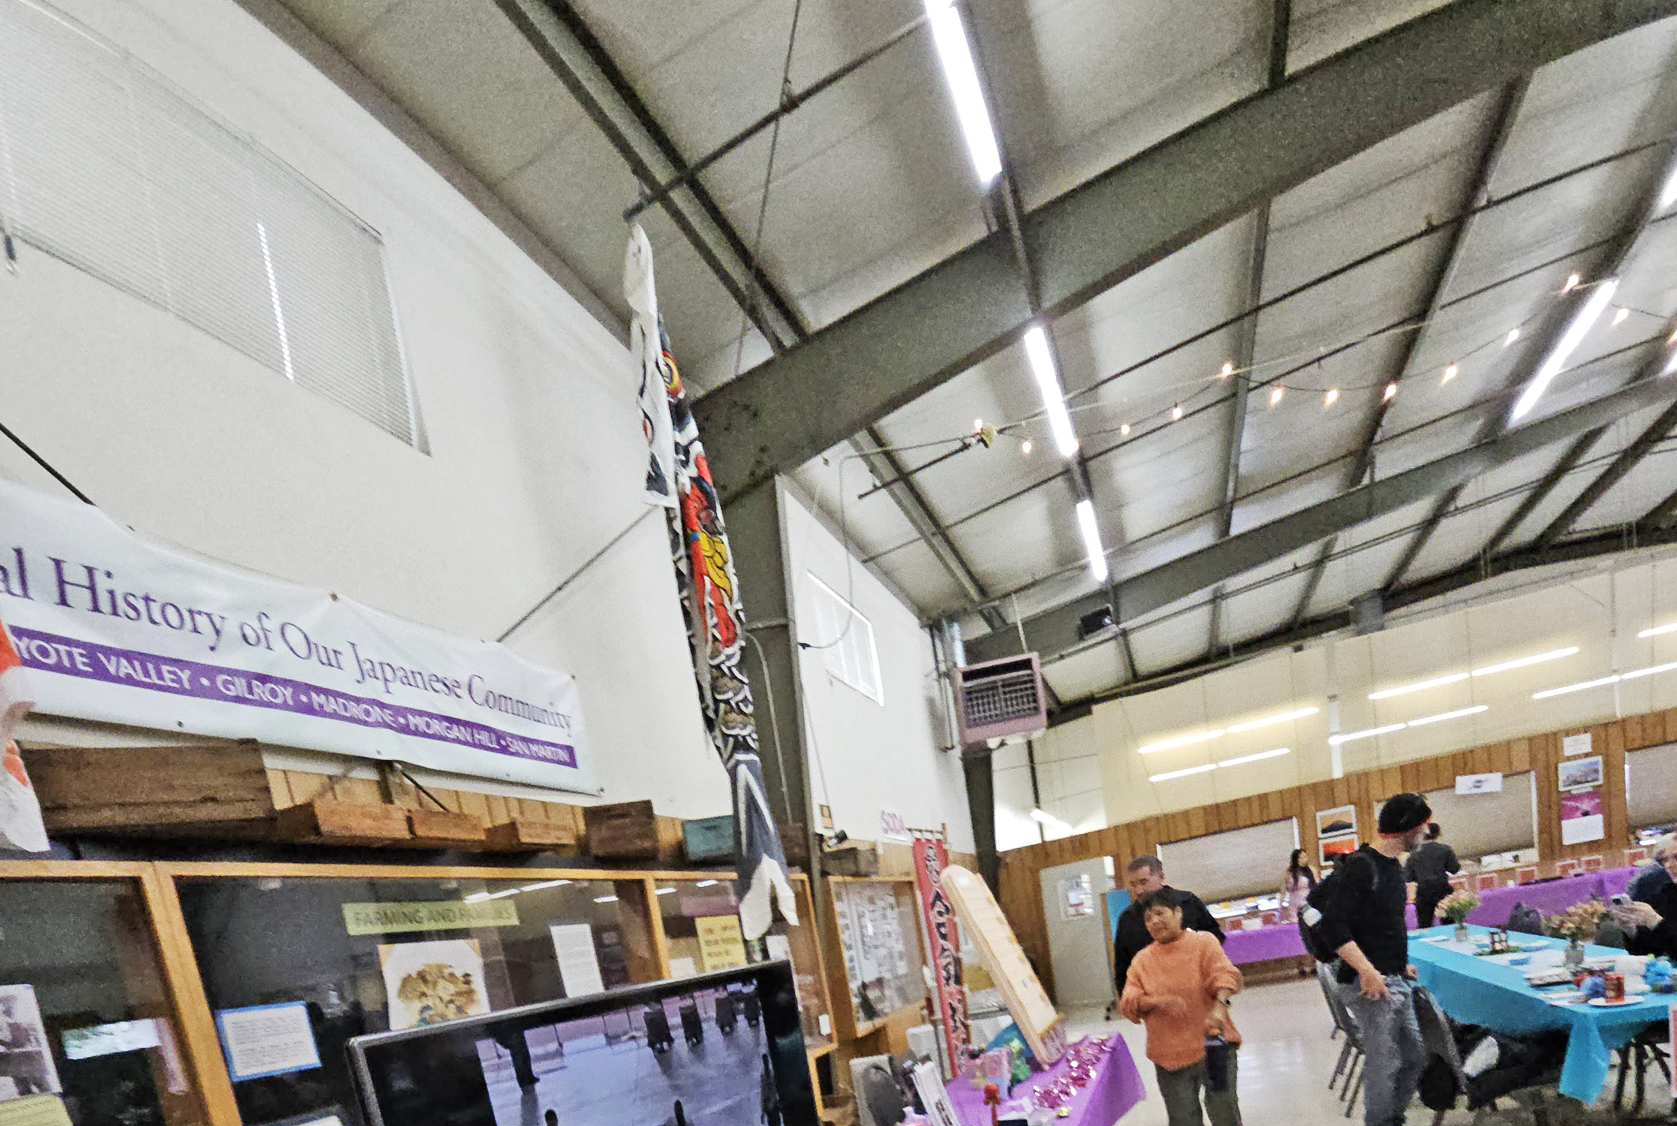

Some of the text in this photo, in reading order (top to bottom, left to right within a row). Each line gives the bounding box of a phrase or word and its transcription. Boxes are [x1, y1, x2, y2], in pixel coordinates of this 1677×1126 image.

[47, 556, 227, 652] History
[239, 611, 275, 652] of
[281, 621, 345, 671] Our
[347, 640, 464, 700] Japanese
[468, 673, 573, 738] Community
[97, 652, 193, 690] VALLEY
[215, 674, 294, 706] GILROY
[310, 691, 398, 728] MADRONE
[407, 713, 473, 743] MORGAN
[473, 728, 501, 749] HILL
[505, 736, 531, 757] SAN
[528, 742, 570, 763] MARTIN
[354, 908, 424, 926] FARMING
